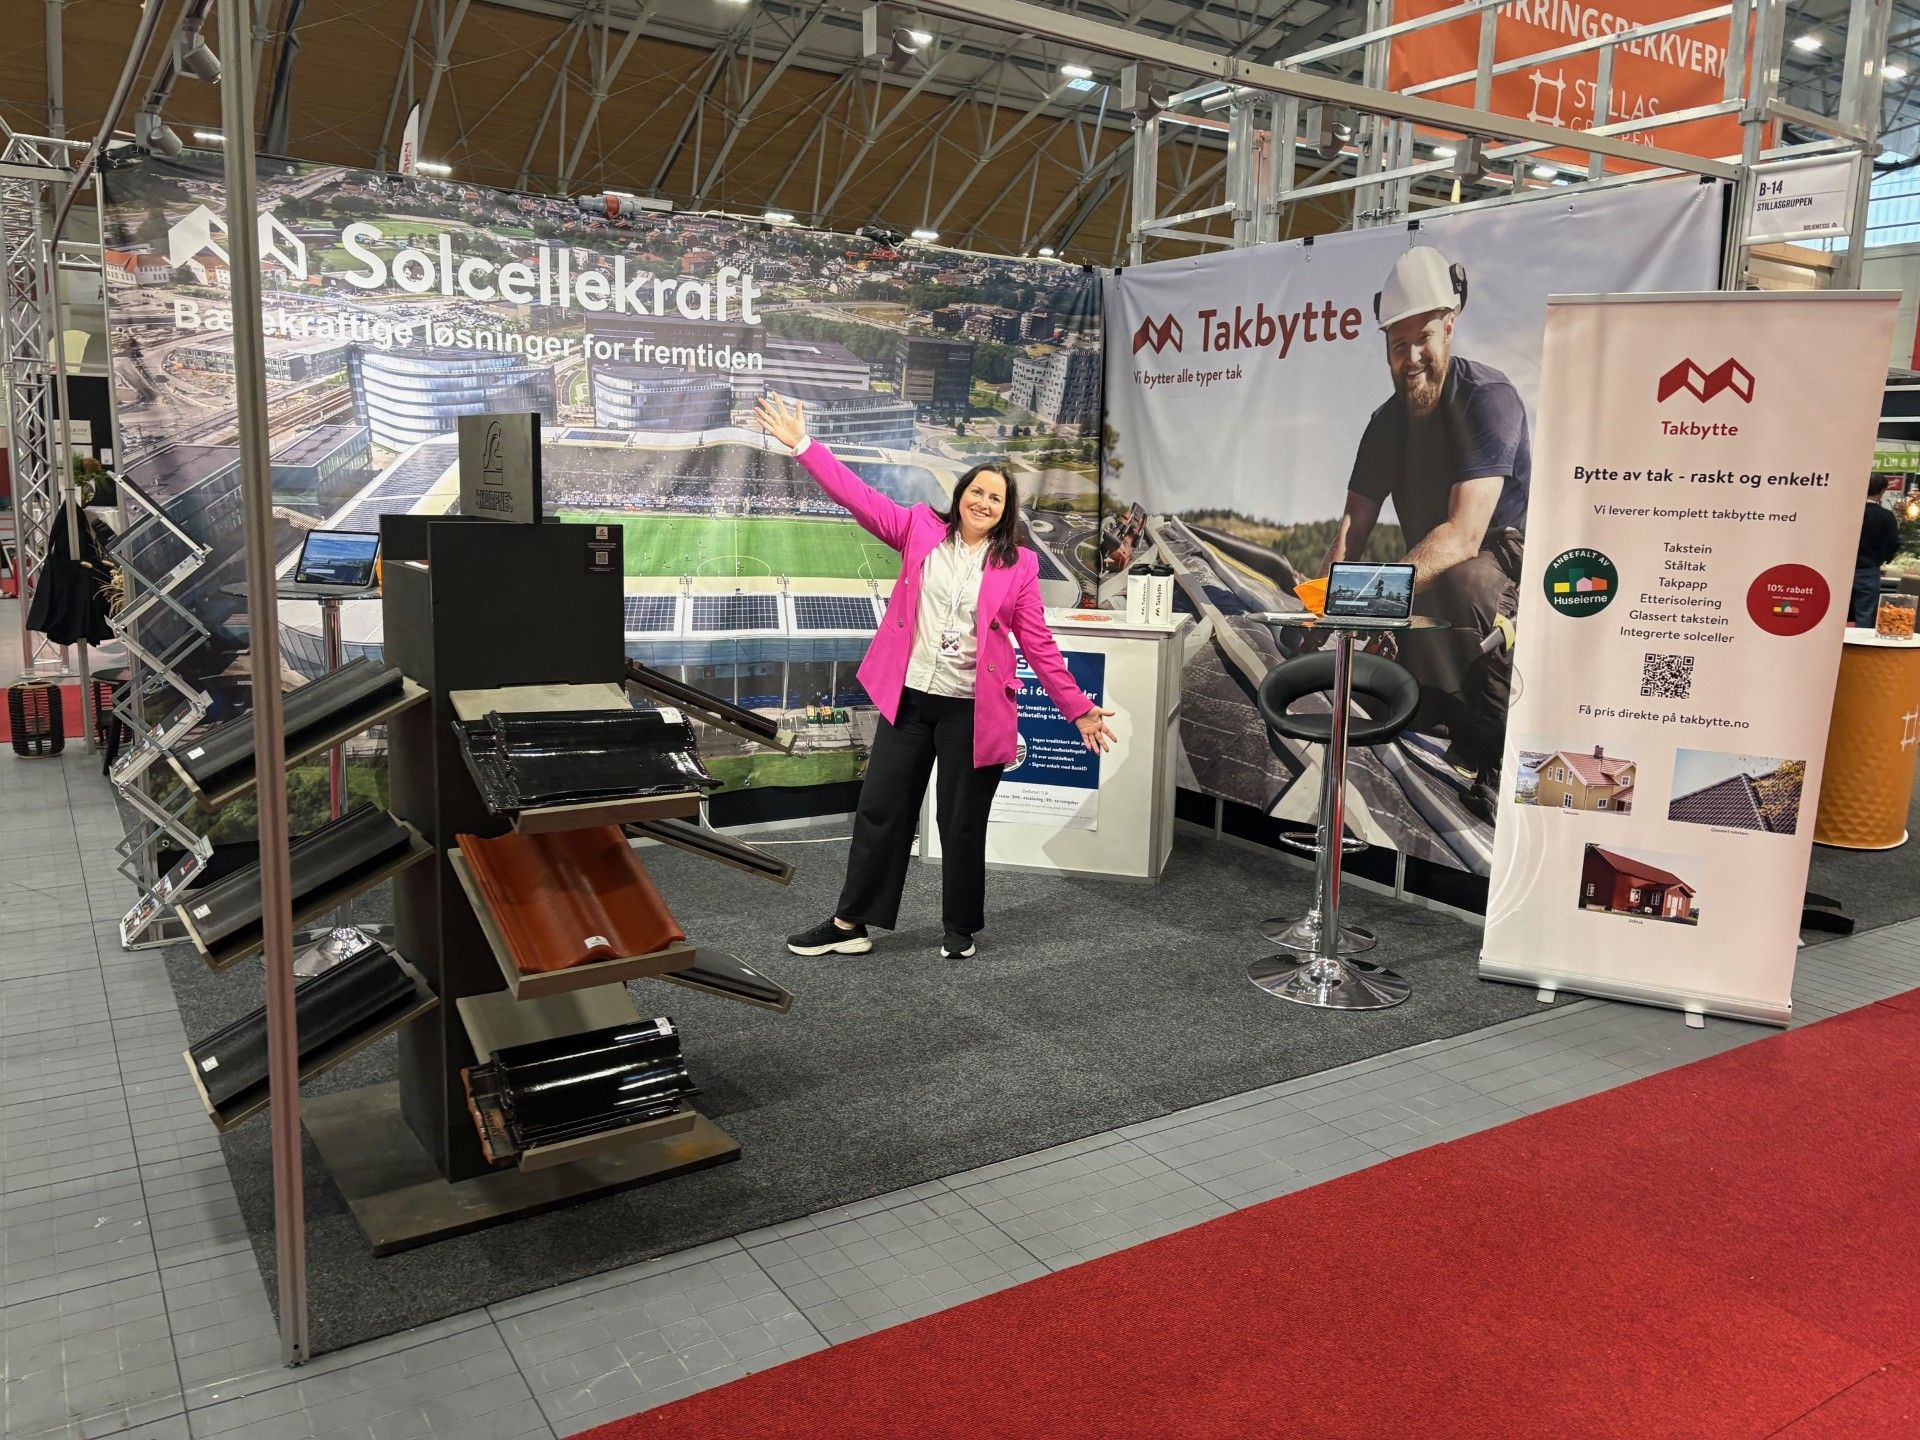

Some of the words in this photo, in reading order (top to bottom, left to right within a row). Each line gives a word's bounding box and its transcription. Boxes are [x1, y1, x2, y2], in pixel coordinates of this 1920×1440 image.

[1574, 79, 1659, 120] STLLAS
[1759, 180, 1783, 196] B-14
[1757, 197, 1813, 212] STILLASGRUPPEN
[342, 222, 762, 325] Solcellekraft
[174, 299, 413, 350] Bæekraftige
[425, 319, 575, 361] løsninger
[583, 333, 625, 361] for
[633, 337, 763, 370] fremtiden
[1198, 300, 1362, 359] Takbytte
[1133, 370, 1142, 384] Vi
[1143, 368, 1174, 390] bytter
[1176, 368, 1193, 383] alle
[1196, 368, 1223, 387] typer
[1226, 364, 1242, 380] tak
[1661, 420, 1739, 440] Takbytte
[1574, 466, 1618, 483] Bytte
[1622, 470, 1642, 482] av
[1646, 468, 1673, 483] tak
[1690, 469, 1734, 484] raskt
[1739, 474, 1762, 489] og
[1767, 472, 1830, 487] enkelt!
[1594, 504, 1606, 515] Vi
[1608, 505, 1650, 517] leverer
[1653, 507, 1709, 521] komplett
[1711, 509, 1765, 522] takbytte
[1768, 511, 1797, 522] med
[1663, 542, 1712, 554] Takstein
[1553, 551, 1597, 569] ANBEFALT
[1598, 556, 1610, 567] AV
[1664, 560, 1706, 572] Ståltak
[1659, 577, 1708, 591] Takpapp
[1767, 584, 1784, 593] 10%
[1786, 586, 1814, 595] rabatt
[1554, 595, 1608, 605] Huseierne
[1640, 593, 1722, 610] Etterisolering
[1629, 610, 1677, 623] Glassert
[1680, 613, 1729, 626] takstein
[1620, 626, 1680, 640] Integrerte
[1683, 631, 1734, 643] solceller
[1578, 704, 1591, 715] Få
[1594, 706, 1615, 718] pris
[1618, 708, 1659, 721] direkte
[1662, 713, 1676, 724] på
[1680, 714, 1750, 729] takbytte.no
